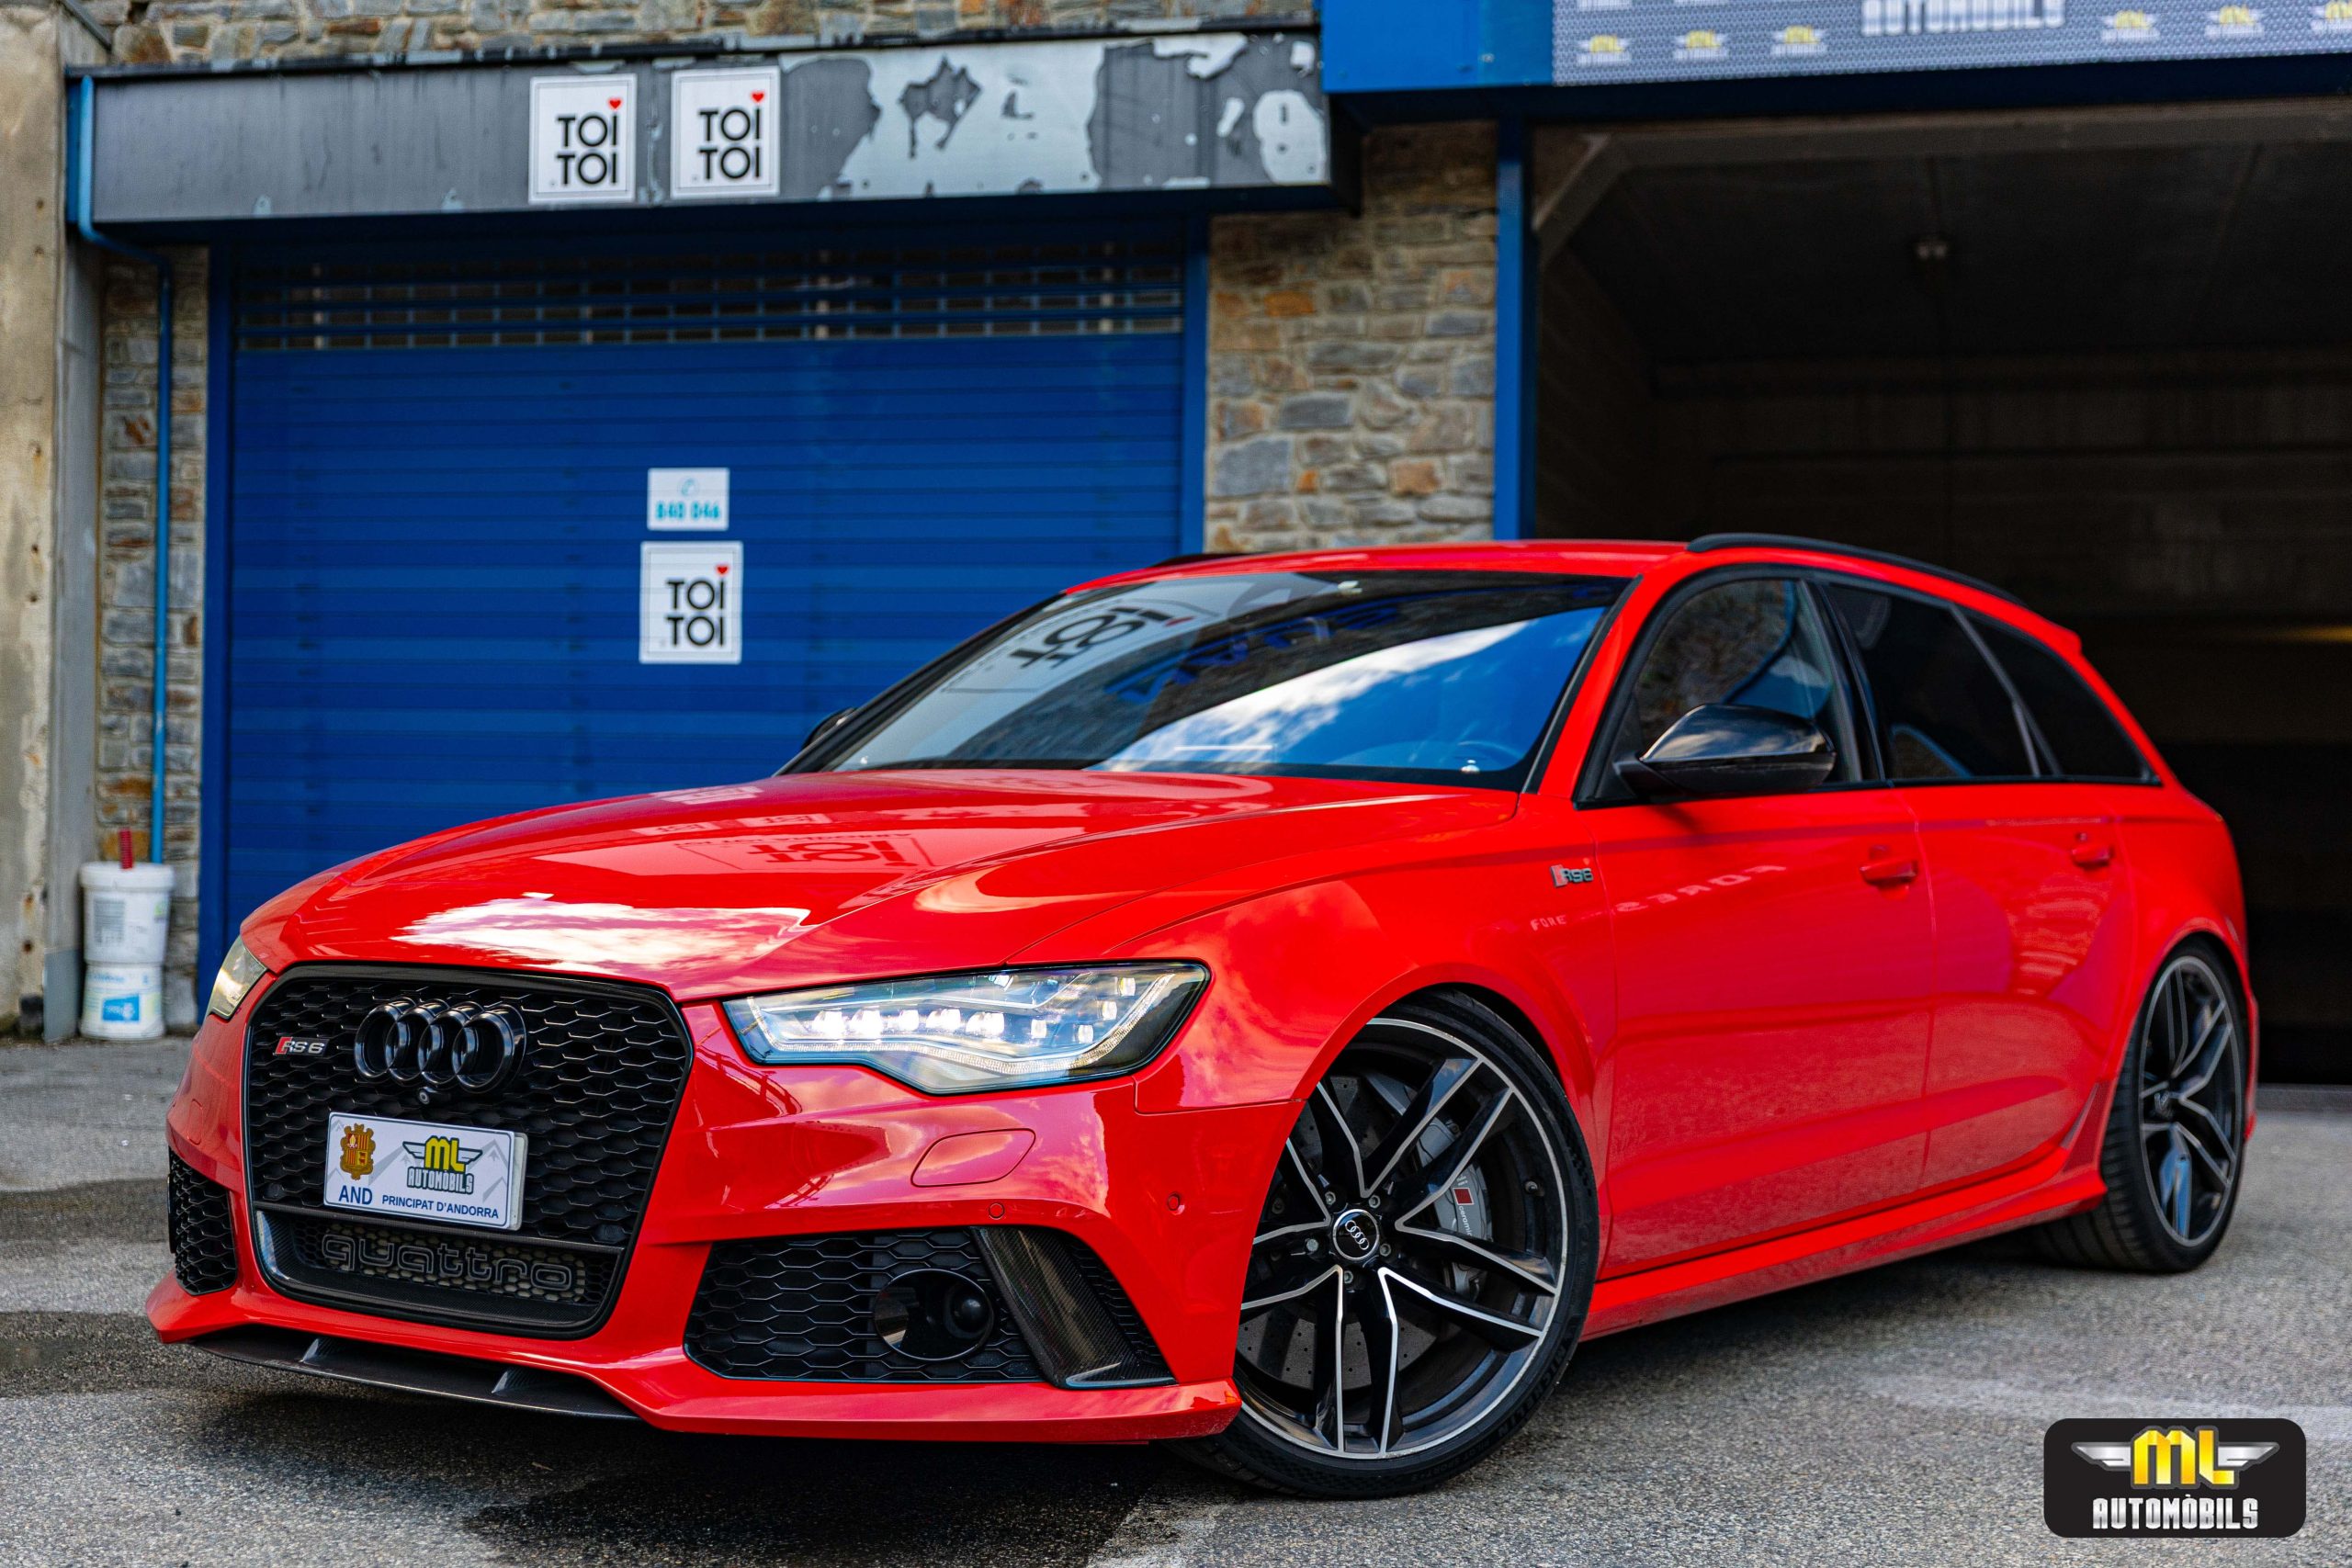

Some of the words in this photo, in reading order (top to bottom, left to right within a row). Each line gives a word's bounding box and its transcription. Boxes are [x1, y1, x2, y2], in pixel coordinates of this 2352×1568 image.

[556, 151, 618, 186] TOI
[698, 145, 762, 181] TOI
[665, 615, 725, 648] TOI
[424, 1134, 467, 1173] ML
[338, 1185, 373, 1205] AND
[381, 1194, 434, 1211] PRINCIPAT
[435, 1202, 500, 1220] D'ANDORRA
[322, 1234, 572, 1291] quattro
